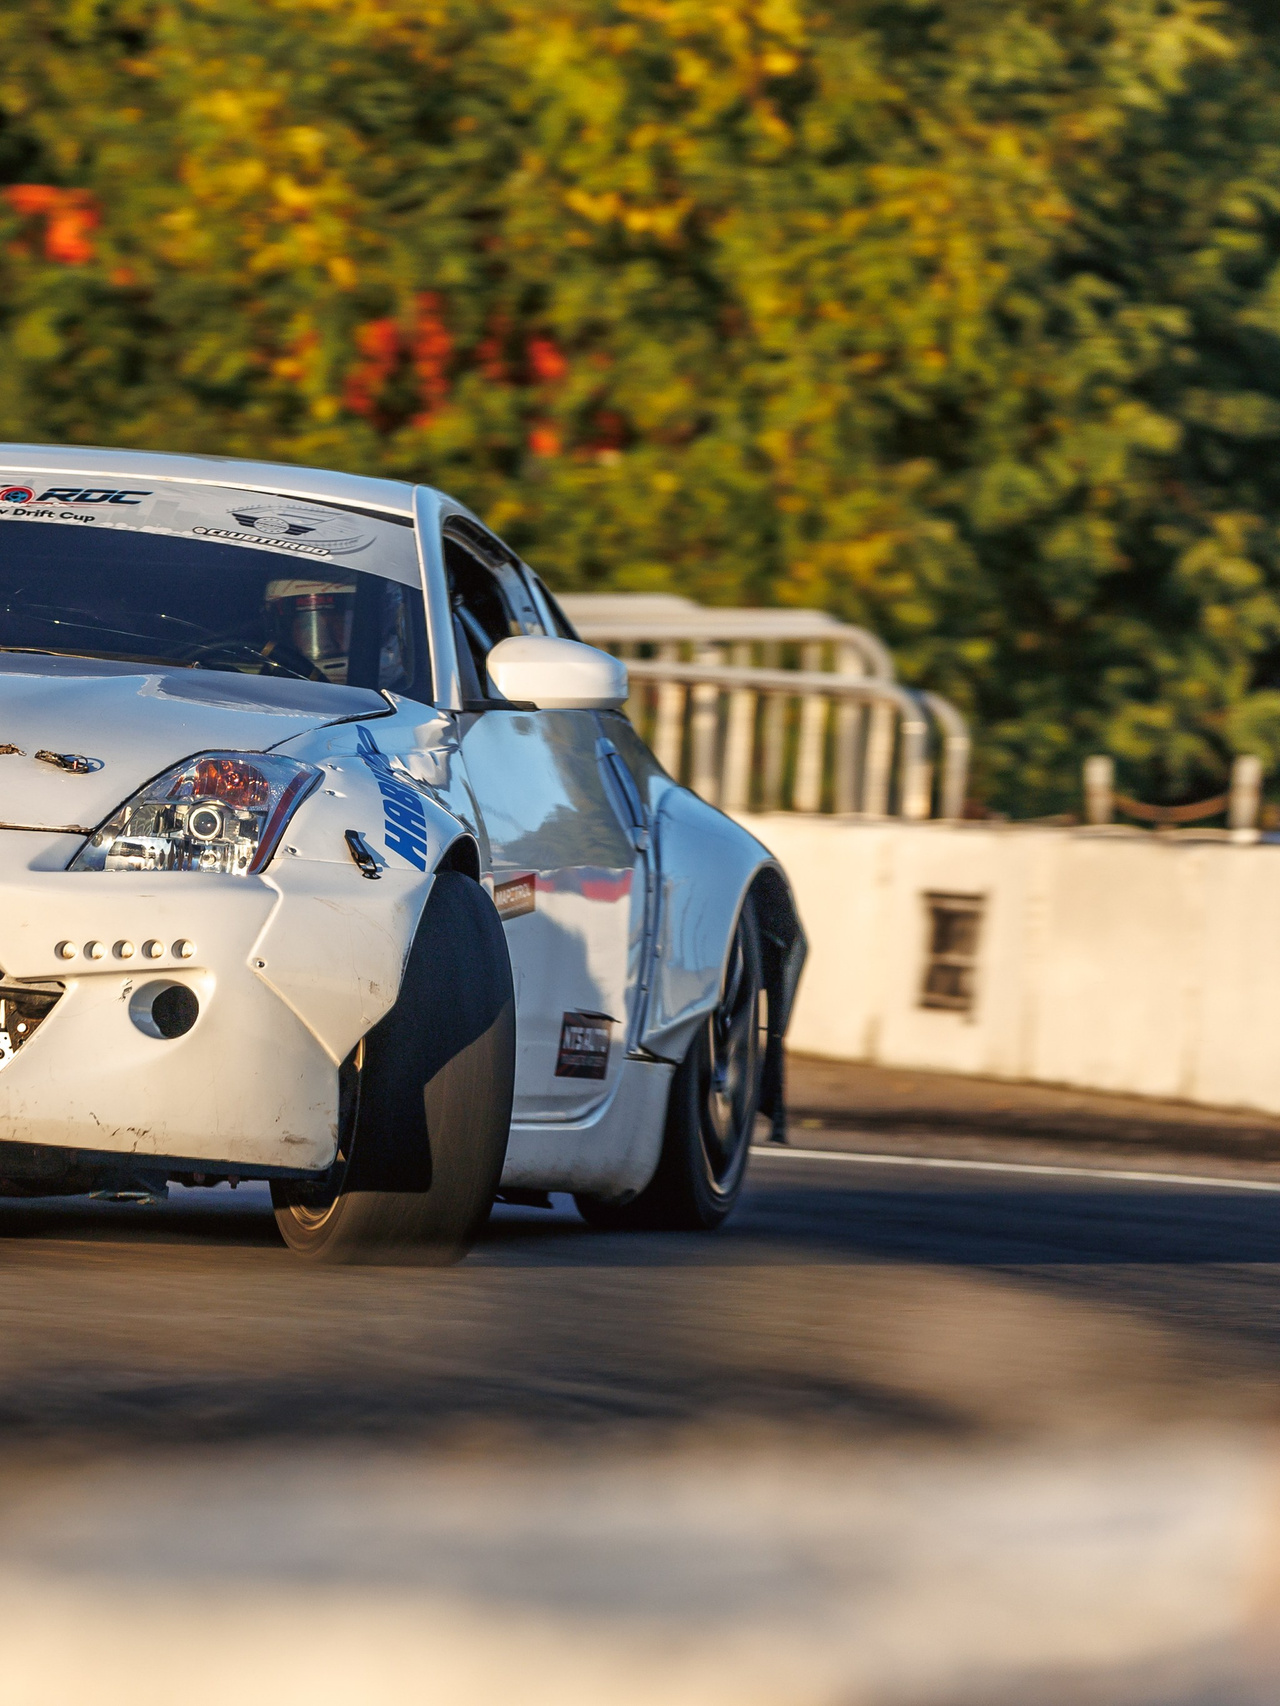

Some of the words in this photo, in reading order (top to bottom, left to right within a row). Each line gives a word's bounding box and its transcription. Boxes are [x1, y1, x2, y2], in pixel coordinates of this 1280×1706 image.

[35, 488, 154, 505] RDC
[12, 508, 55, 519] Drift
[59, 511, 96, 523] Cup
